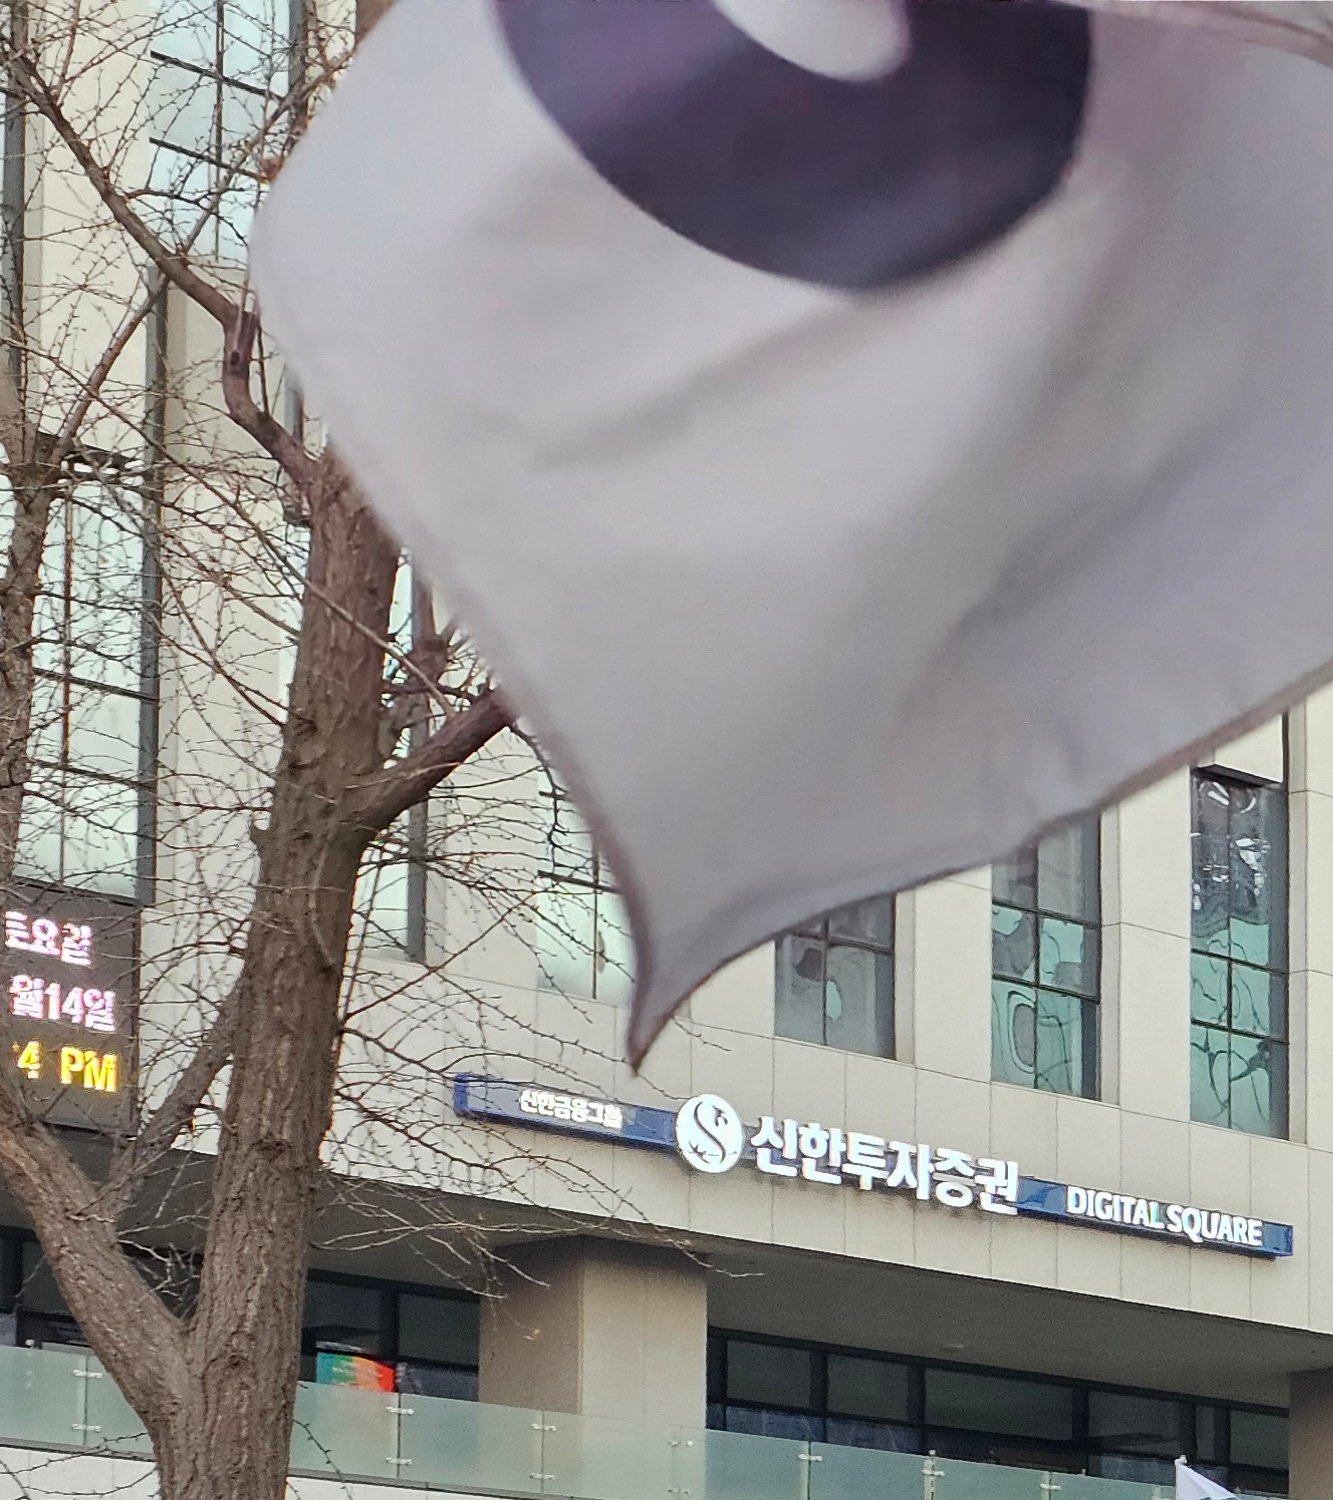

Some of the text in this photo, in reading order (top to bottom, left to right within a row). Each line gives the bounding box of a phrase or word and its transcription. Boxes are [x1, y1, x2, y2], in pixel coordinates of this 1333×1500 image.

[4, 910, 93, 967] 토요일
[60, 1046, 118, 1093] PM
[750, 1115, 1020, 1217] 신한투자증권
[1066, 1184, 1264, 1248] DIGITAL SQUARE
